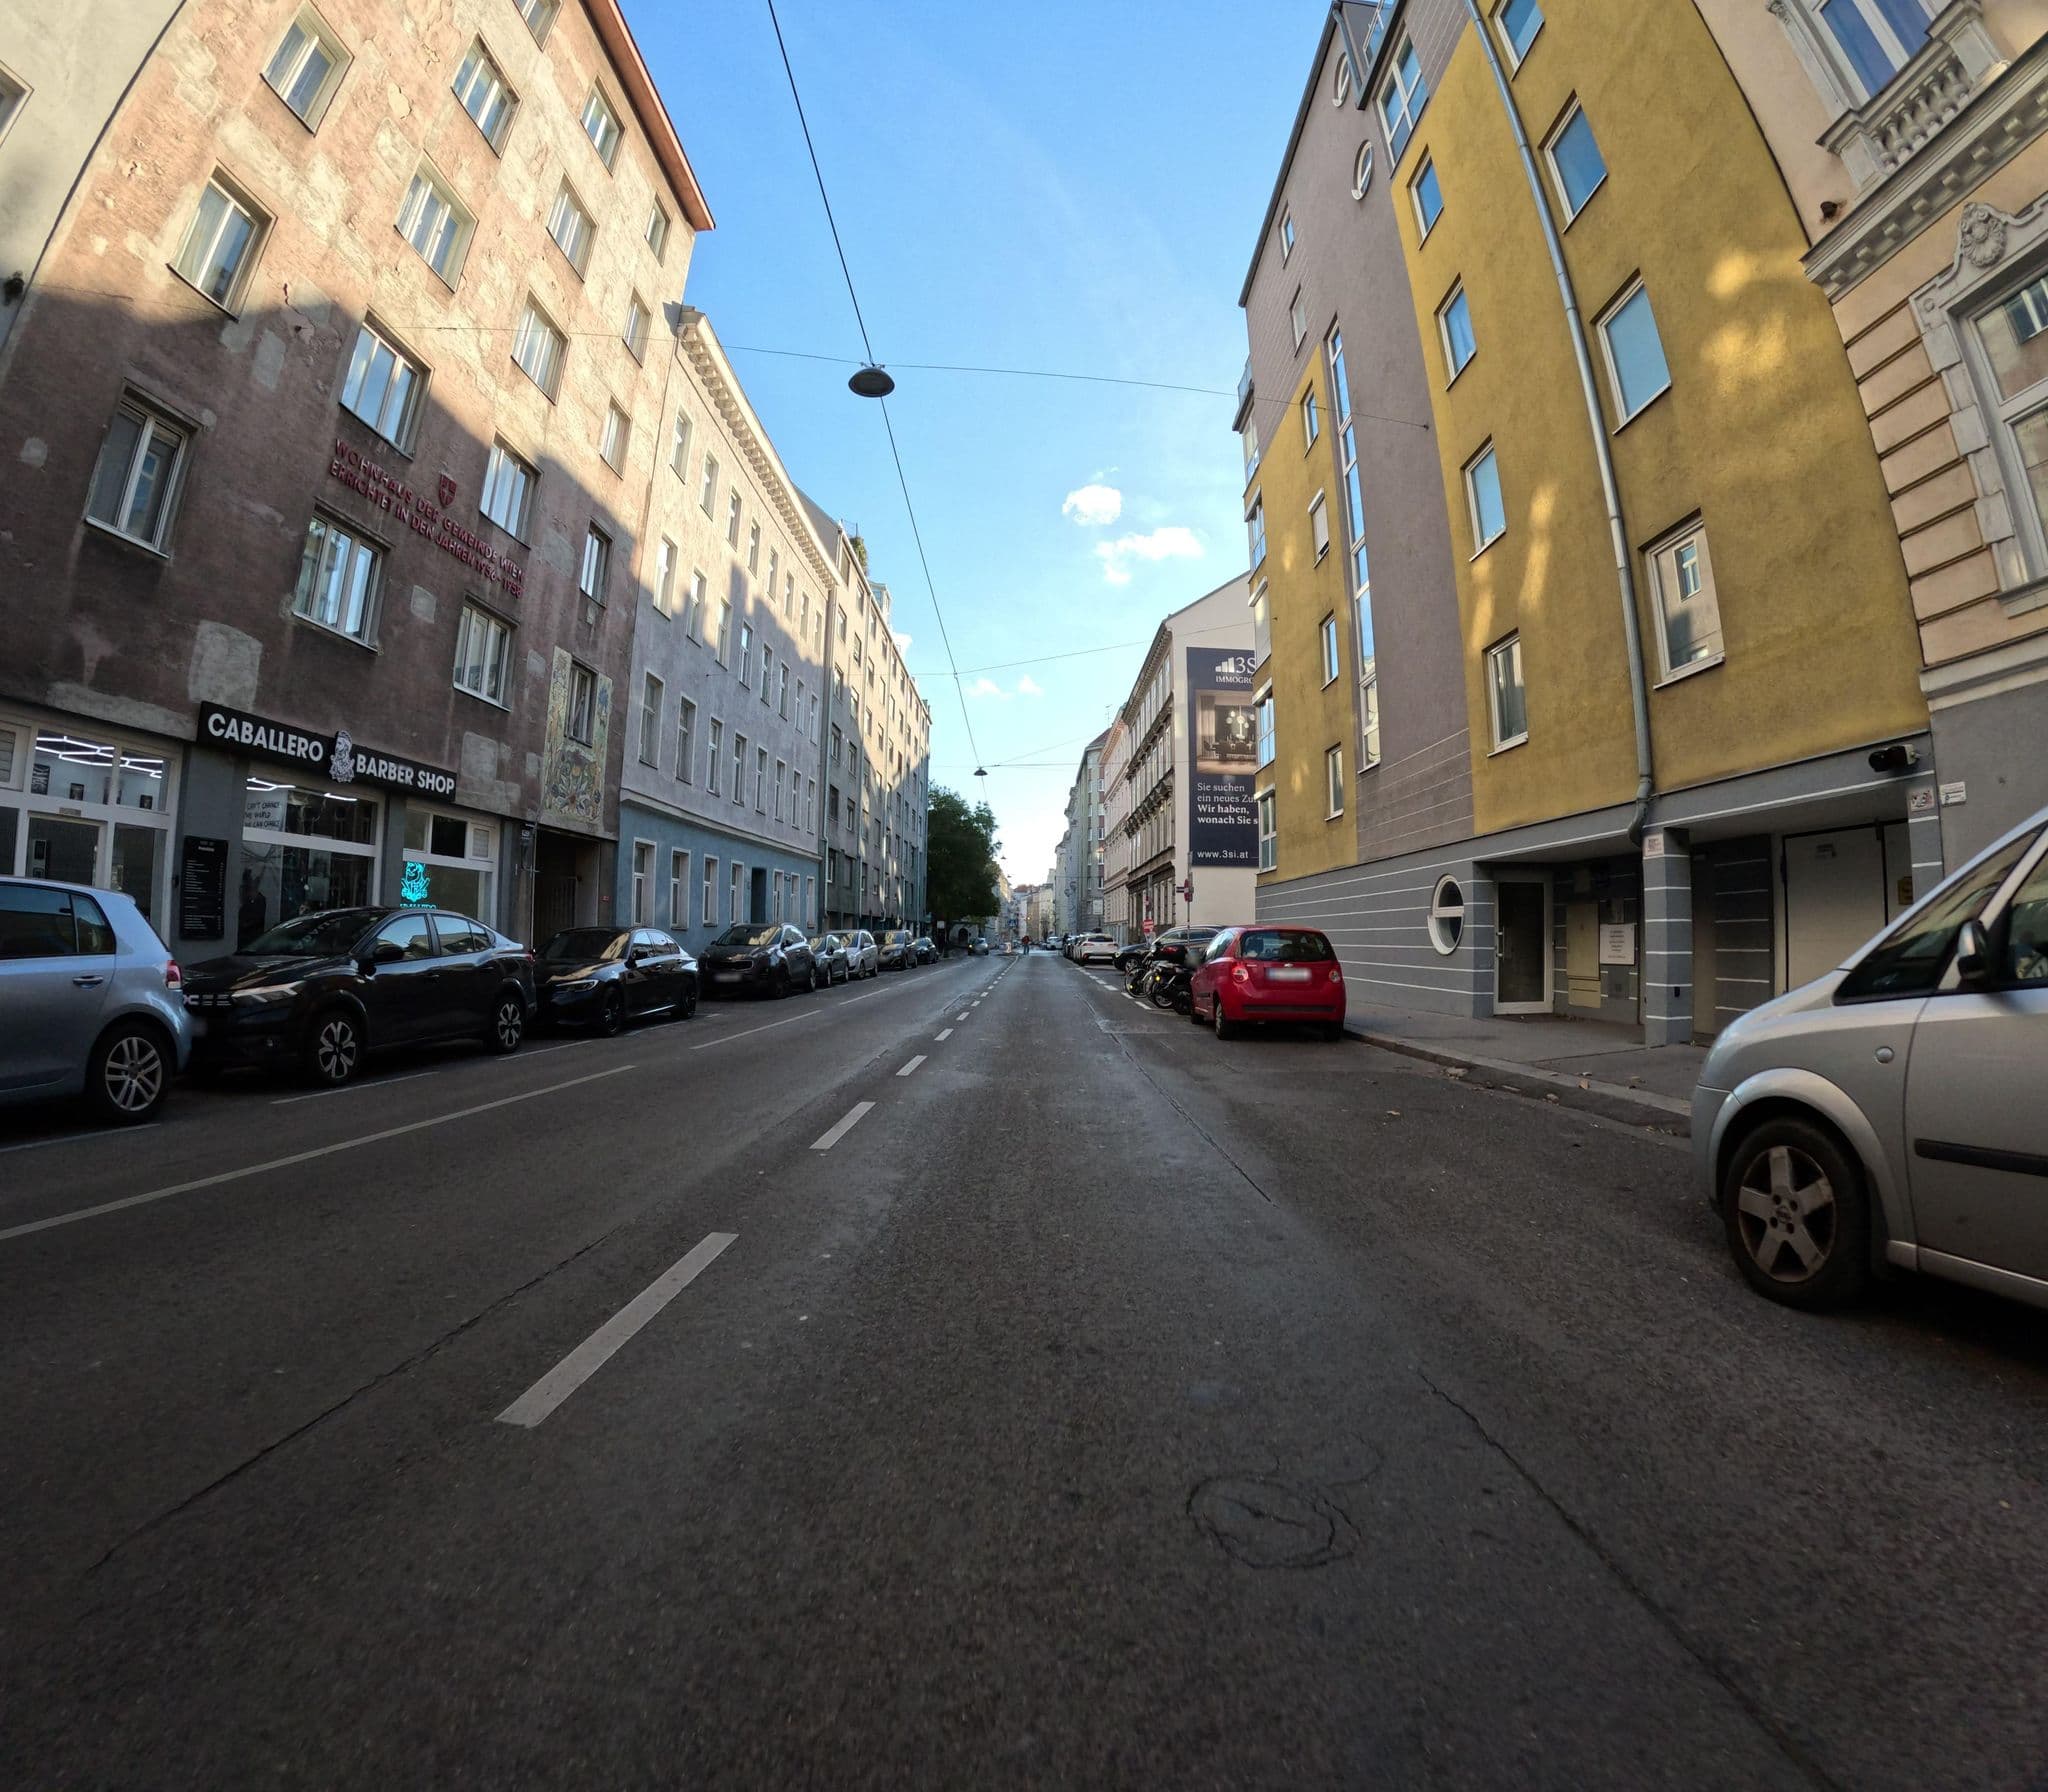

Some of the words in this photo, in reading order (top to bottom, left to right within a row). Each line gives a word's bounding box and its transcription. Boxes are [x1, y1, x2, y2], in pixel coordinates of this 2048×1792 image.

[330, 459, 391, 512] ERRICHTET
[395, 503, 409, 522] IN
[411, 513, 435, 540] DEN
[436, 533, 475, 568] JAHREN
[335, 438, 412, 504] WOHNHAUS
[416, 498, 441, 522] DER
[499, 556, 524, 584] WIEN
[208, 713, 323, 762] CABALLERO
[356, 754, 414, 785] BARBER
[417, 770, 455, 794] SHOP
[1197, 783, 1211, 791] Sie
[1213, 783, 1245, 792] suchen
[1197, 793, 1211, 802] ein
[1197, 804, 1216, 813] Wir
[1217, 804, 1250, 814] haben,
[1197, 815, 1235, 824] wonach
[1236, 816, 1252, 825] Sie
[1197, 850, 1249, 858] www.3si.at
